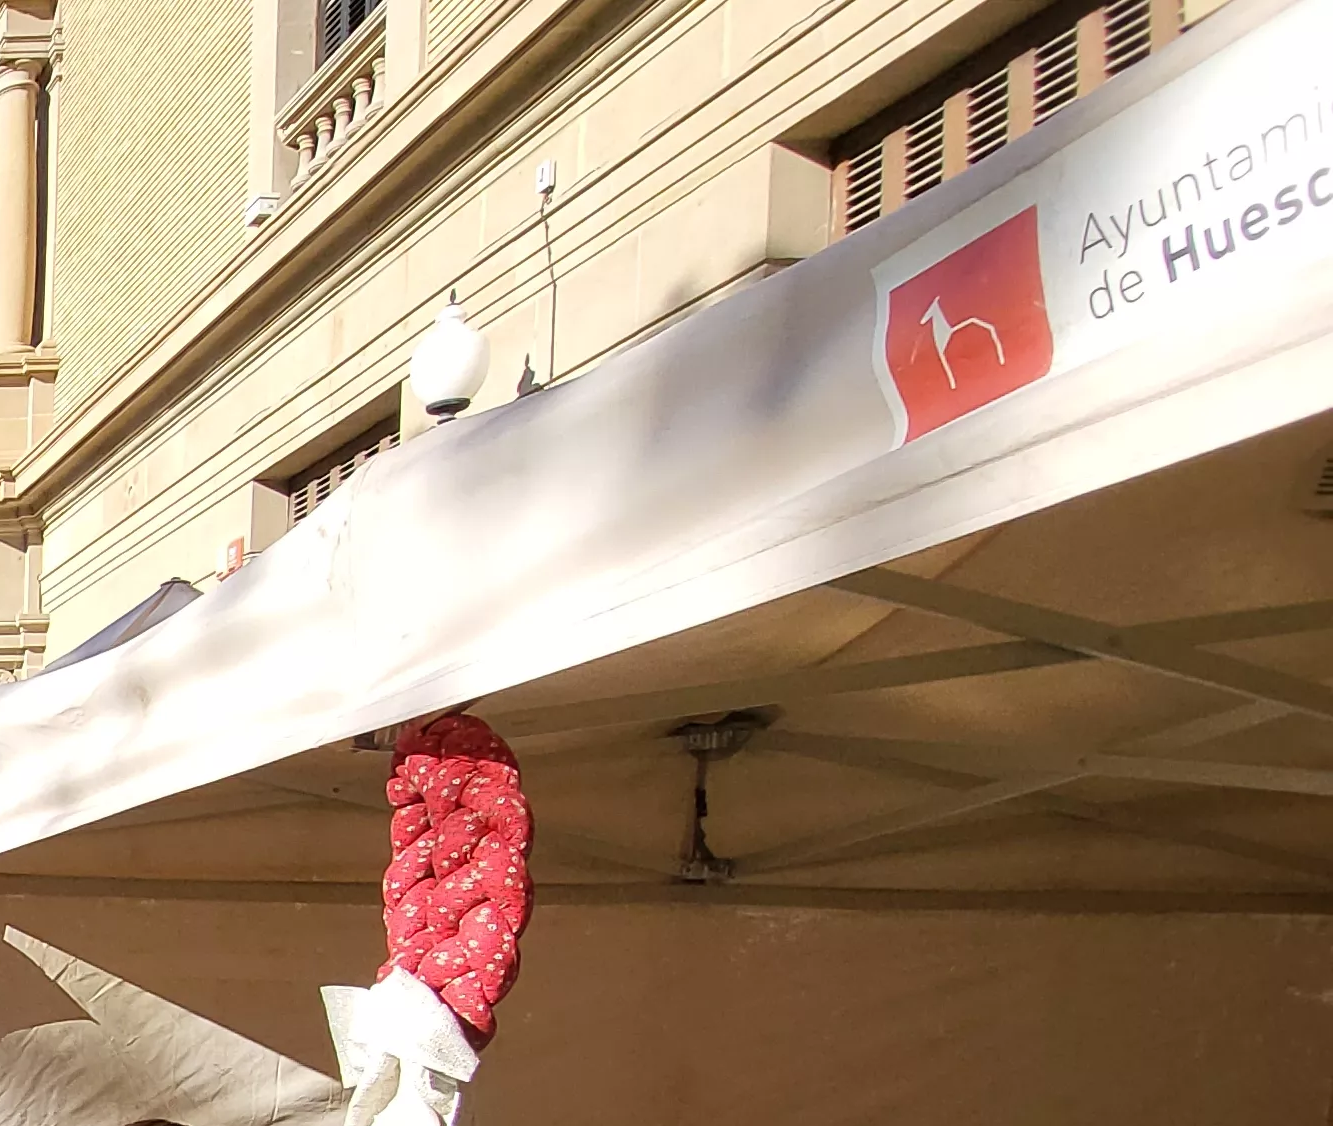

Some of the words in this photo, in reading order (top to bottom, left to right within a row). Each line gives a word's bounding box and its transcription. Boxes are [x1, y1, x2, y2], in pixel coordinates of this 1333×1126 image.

[1080, 86, 1333, 265] Ayuntami
[1088, 269, 1145, 319] de
[1162, 167, 1333, 283] Huesc
